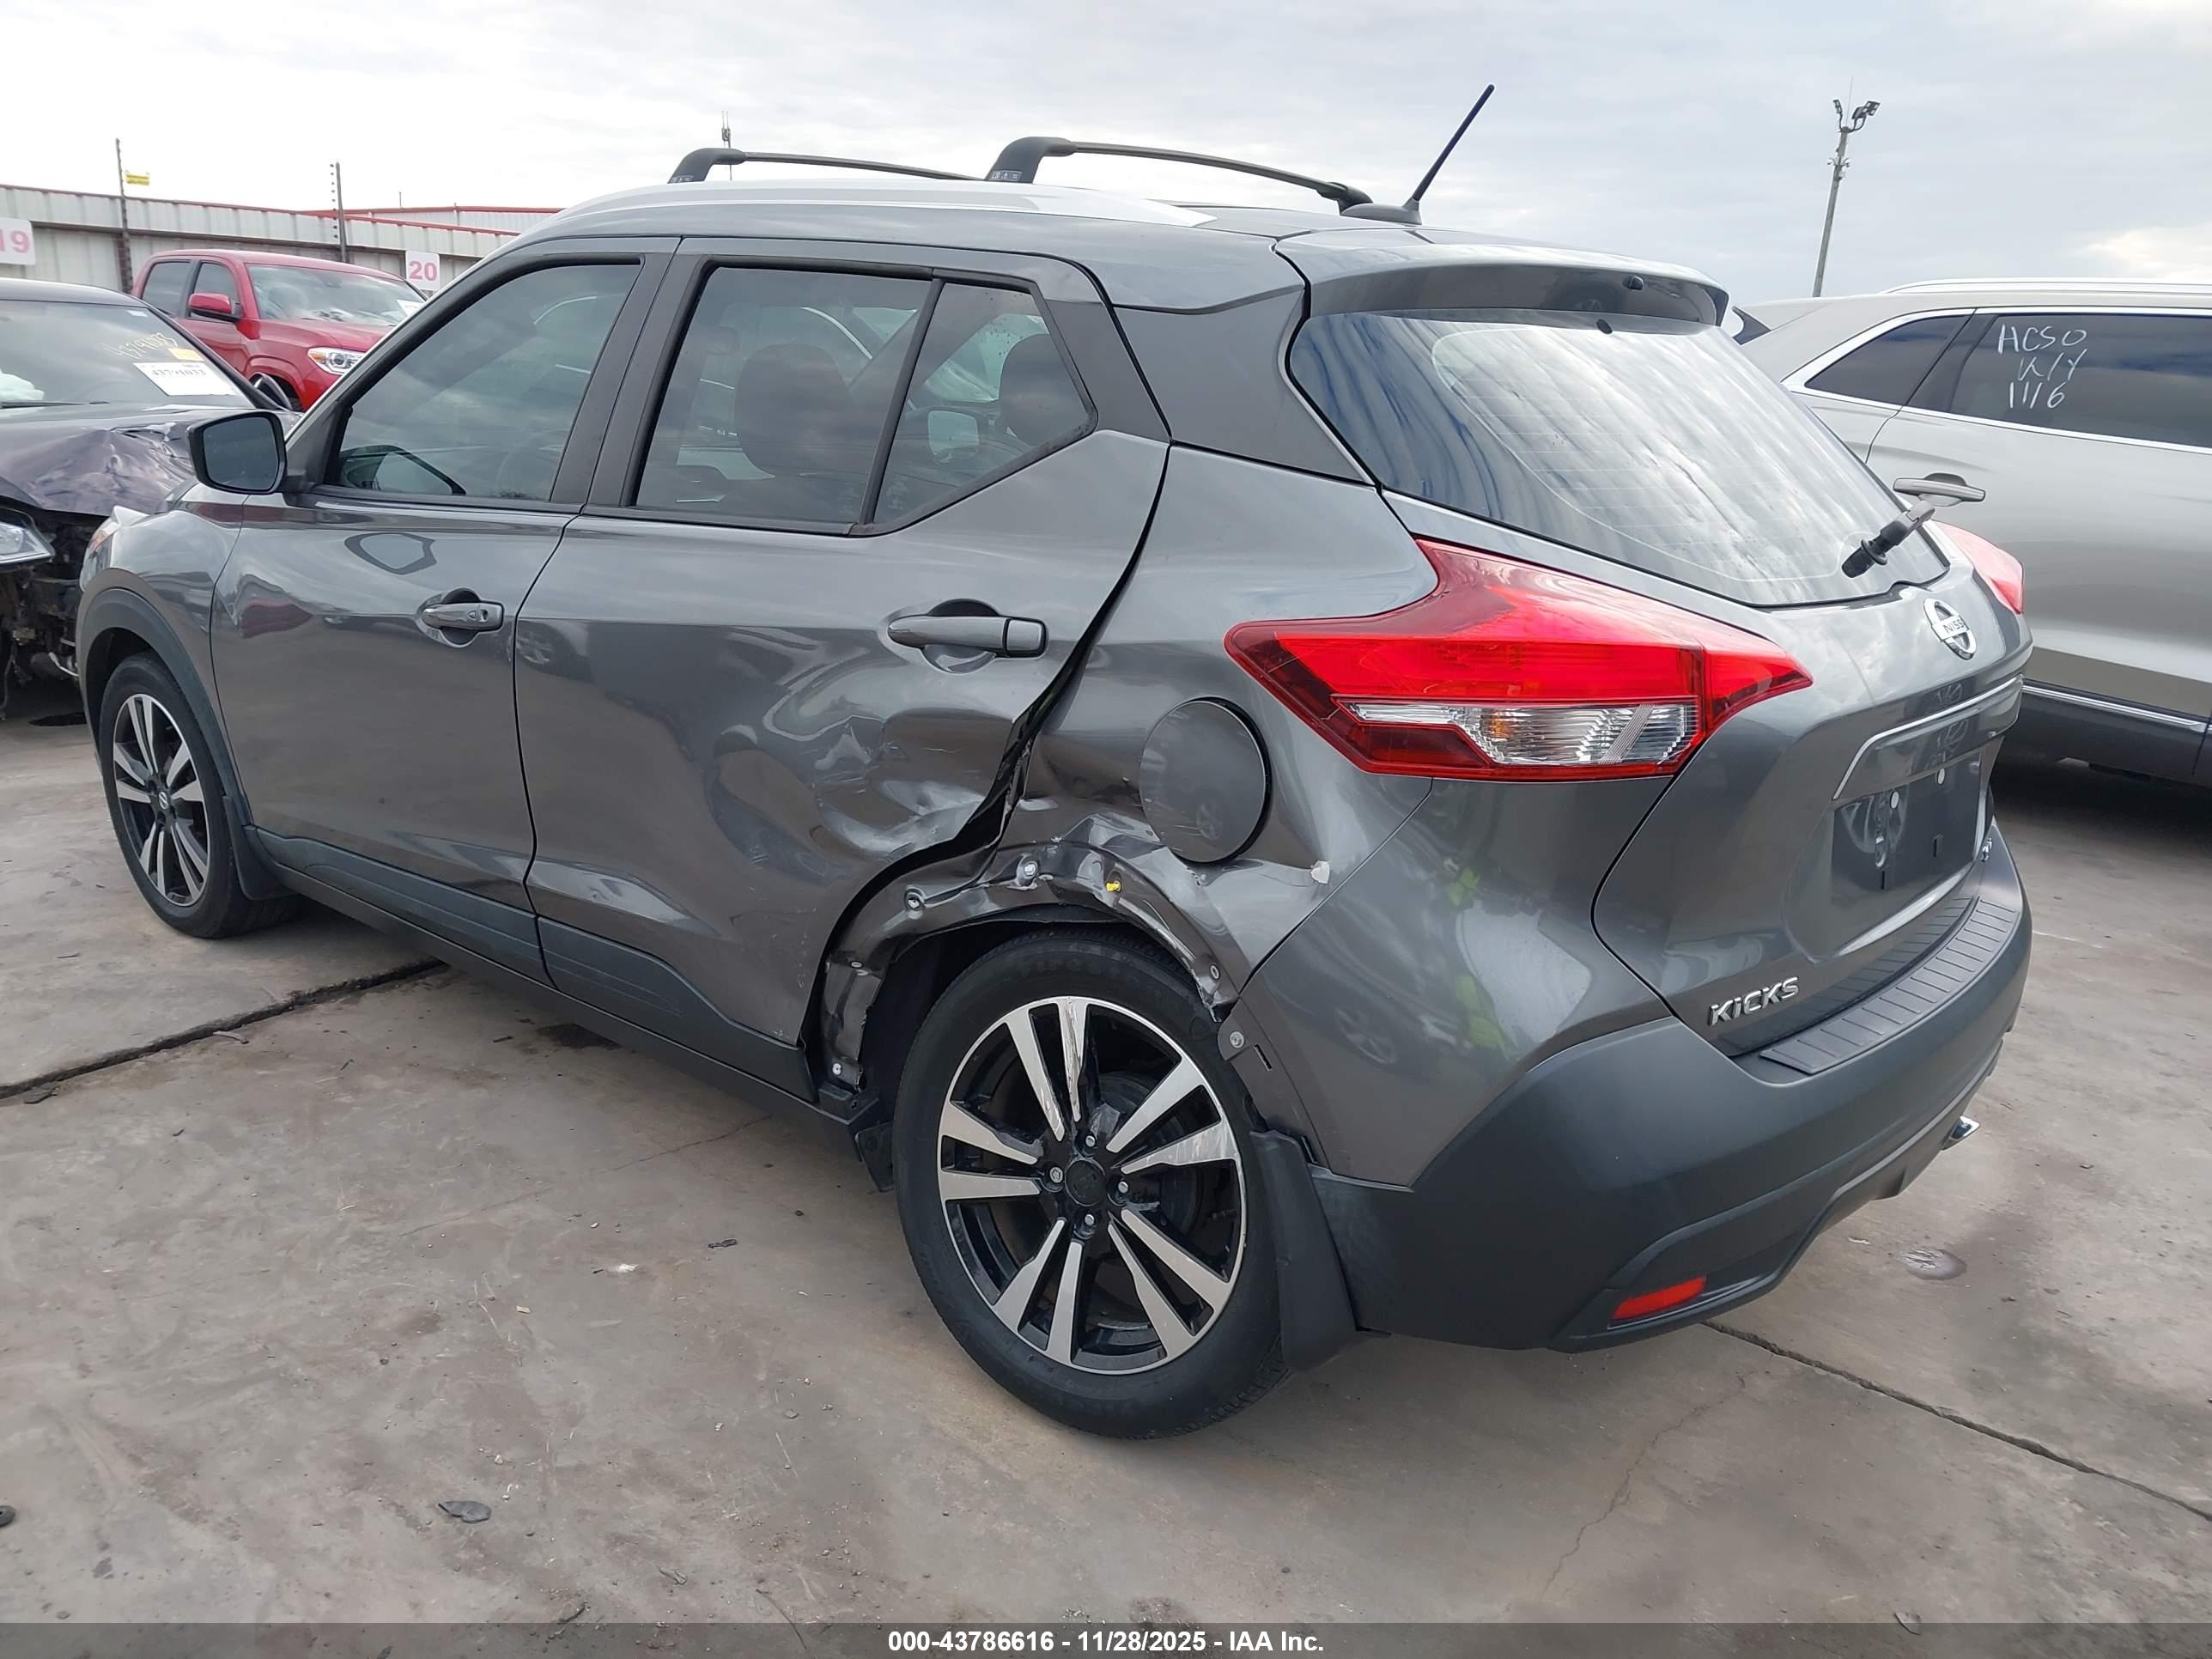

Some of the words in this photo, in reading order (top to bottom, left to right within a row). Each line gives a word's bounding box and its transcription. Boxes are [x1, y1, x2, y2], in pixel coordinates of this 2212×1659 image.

[409, 260, 437, 281] 20
[1997, 324, 2087, 355] HCSO
[1942, 618, 1966, 634] NISS
[1709, 976, 1799, 1026] KICKS
